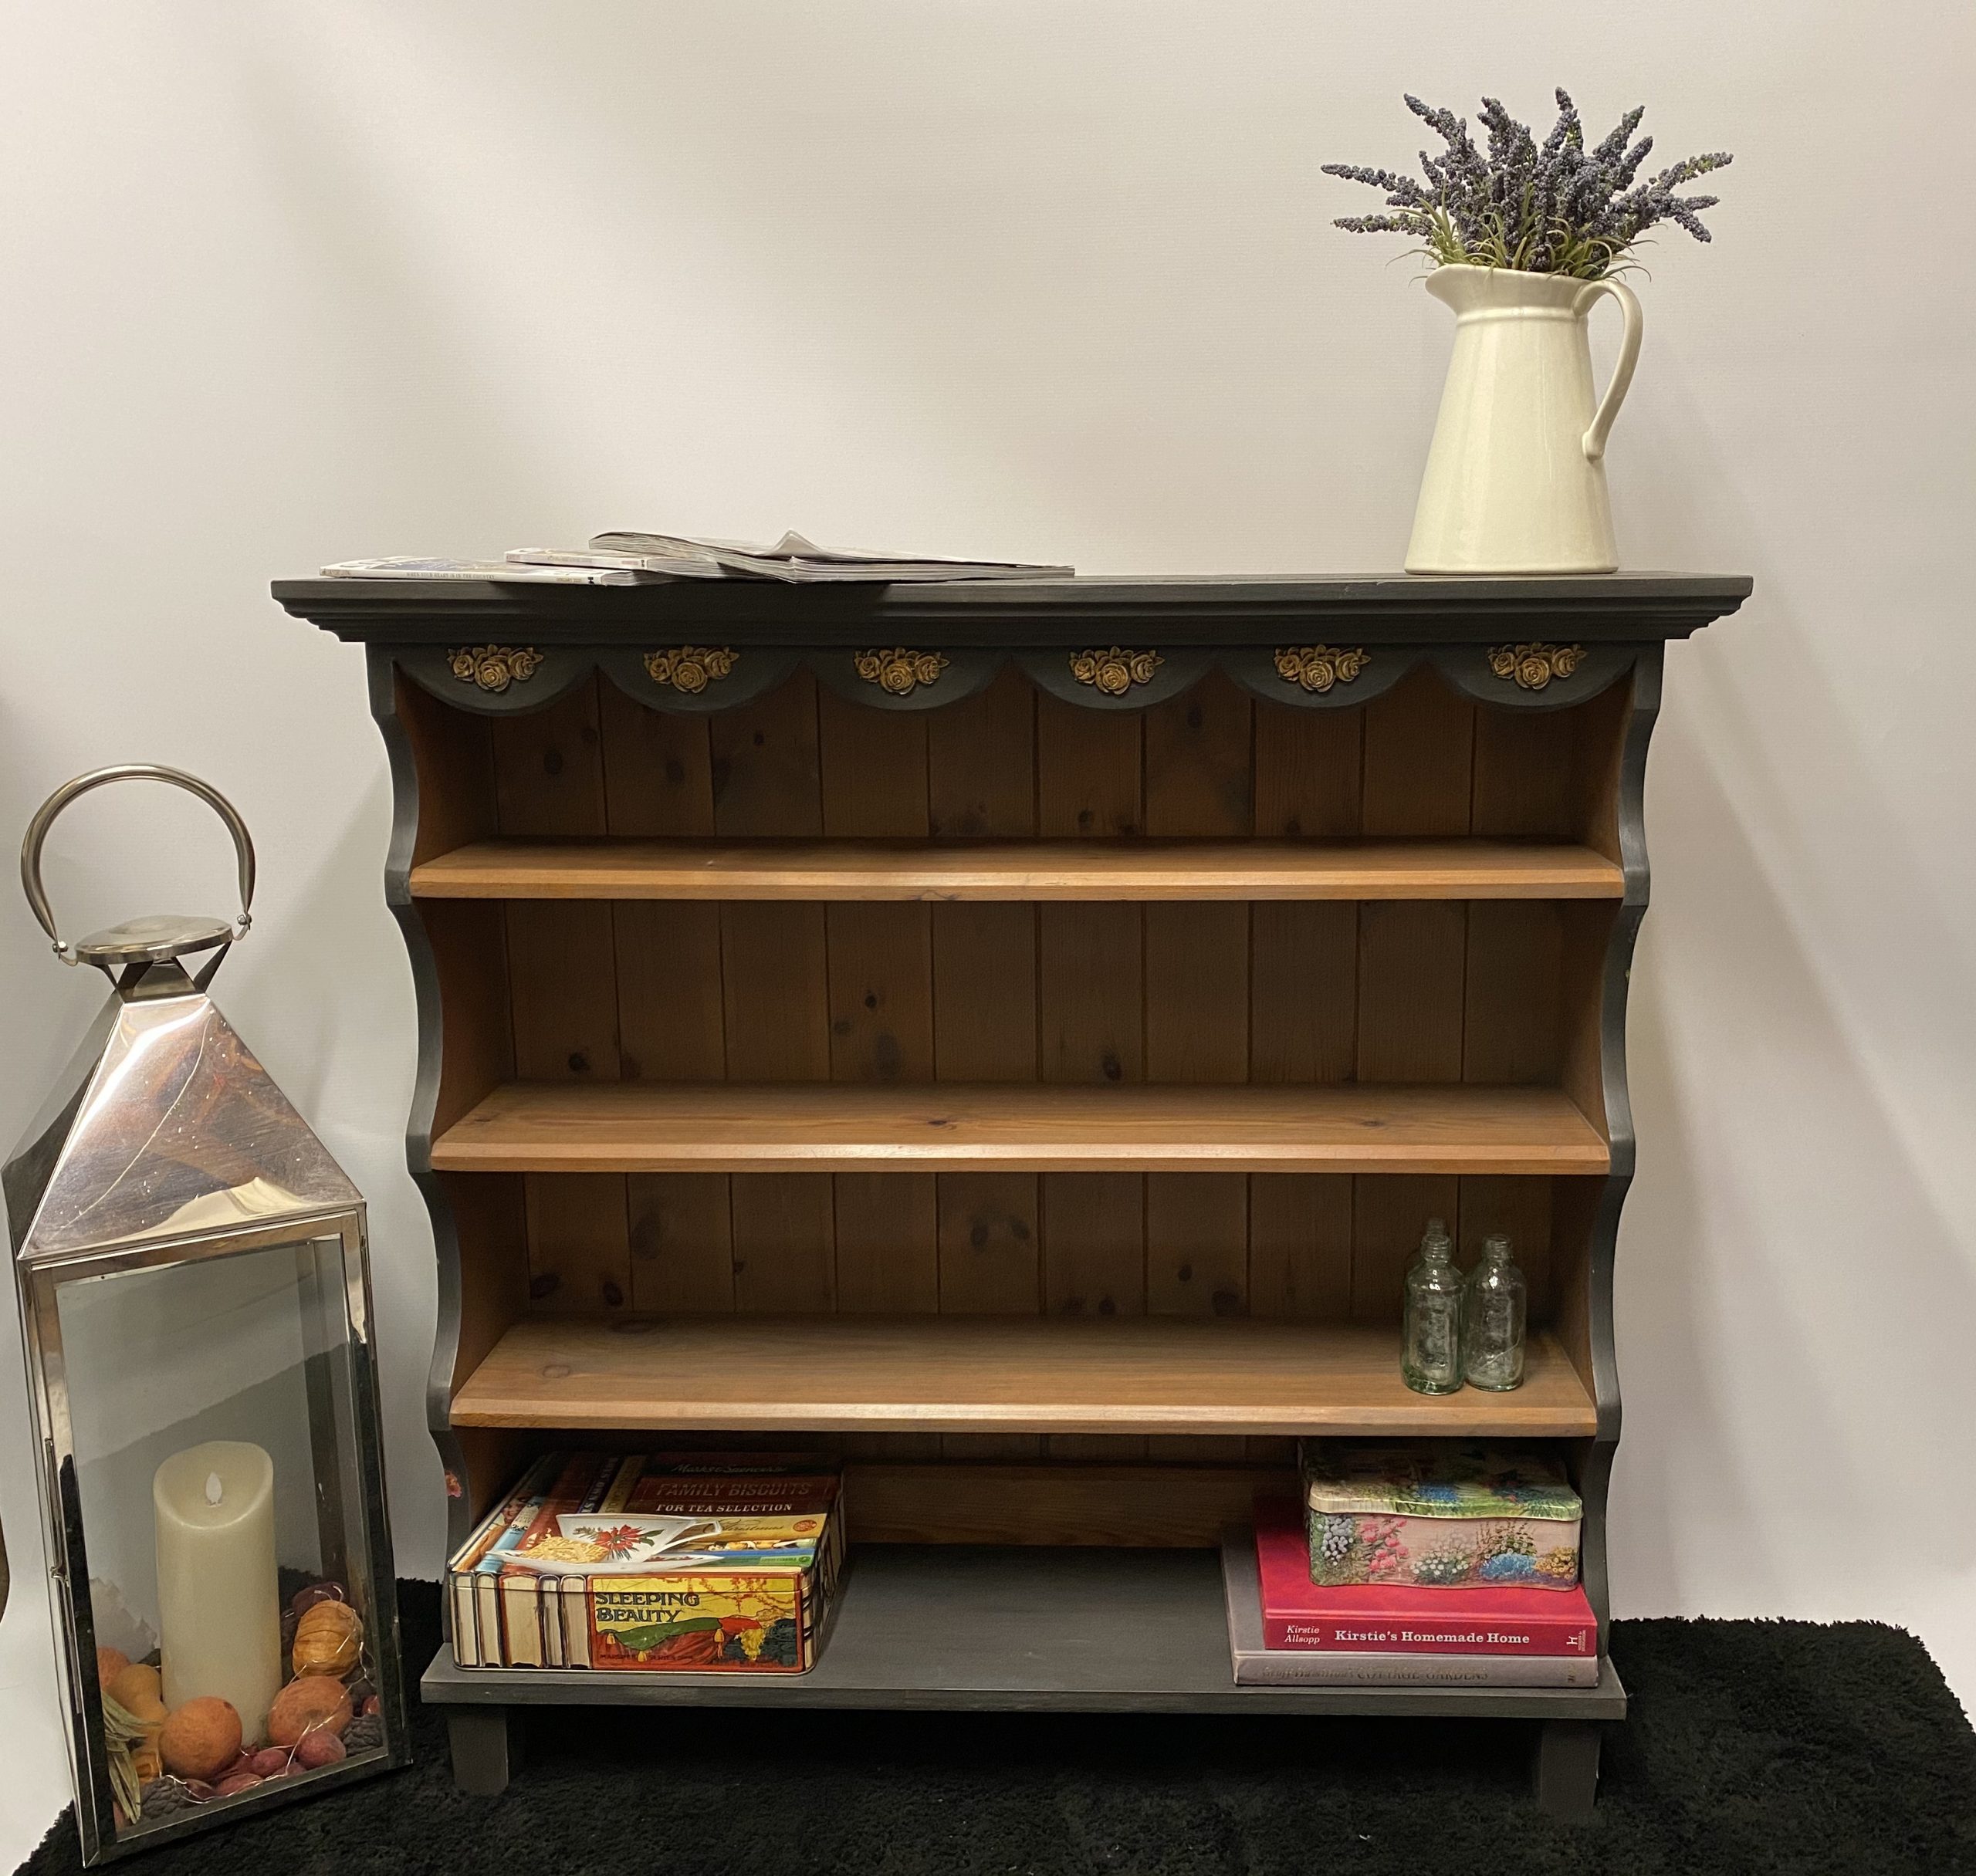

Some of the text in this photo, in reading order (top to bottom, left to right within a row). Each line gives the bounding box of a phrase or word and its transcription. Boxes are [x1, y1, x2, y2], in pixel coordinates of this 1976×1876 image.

[657, 1483, 810, 1496] FAMILY BISCUITS
[689, 1504, 712, 1513] TEA
[716, 1503, 792, 1513] SELECTION
[595, 1592, 700, 1607] SLEEPING
[596, 1607, 682, 1623] BEAUTY
[1287, 1625, 1320, 1634] Kirstie
[1284, 1634, 1321, 1644] Allsopp
[1335, 1631, 1530, 1644] Kirstie's Homemade Home
[1426, 1667, 1489, 1681] GARDENS
